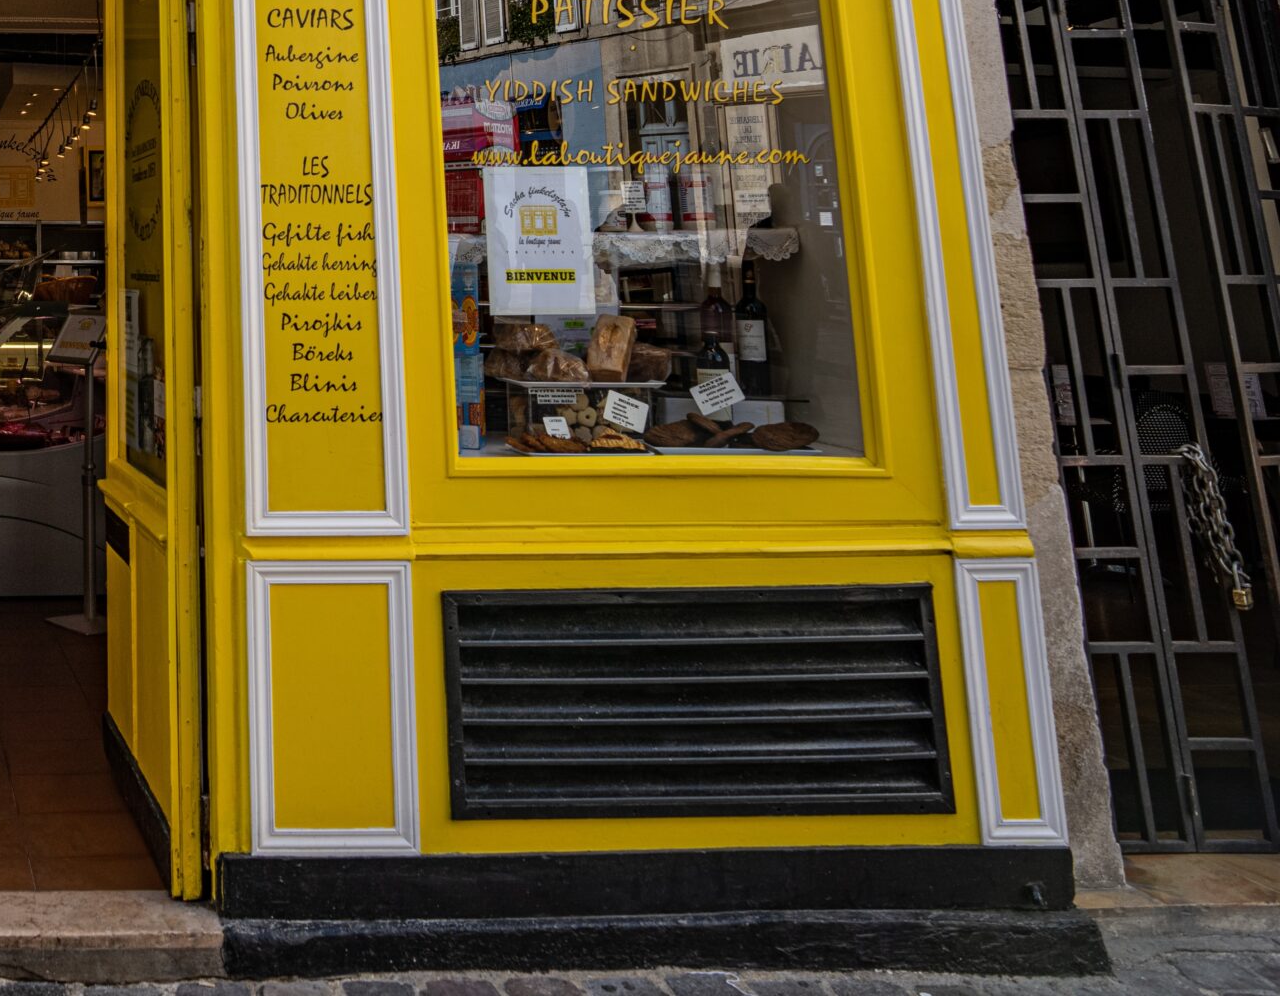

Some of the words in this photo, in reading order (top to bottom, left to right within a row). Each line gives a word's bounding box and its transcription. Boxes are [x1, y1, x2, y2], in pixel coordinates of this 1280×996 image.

[267, 7, 355, 31] CAVIARS
[265, 44, 359, 69] Aubergine
[272, 73, 354, 92] Poivrons
[485, 78, 593, 104] YIDDISH
[607, 78, 785, 105] SANDWICHES
[285, 101, 344, 120] Olives
[302, 155, 330, 178] LES
[471, 140, 811, 174] www.laboutiquejaune.com
[261, 183, 373, 207] TRADITONNELS
[262, 222, 331, 247] Gefilte
[336, 222, 376, 247] fish
[262, 252, 318, 277] Gehakte
[321, 252, 378, 277] herring
[506, 271, 576, 281] BIENVENUE
[263, 282, 325, 307] Gehakte
[281, 312, 362, 338] Pirojkis
[292, 342, 354, 362] Böreks
[290, 373, 358, 392] Blinis
[266, 403, 384, 424] Charcuteries
